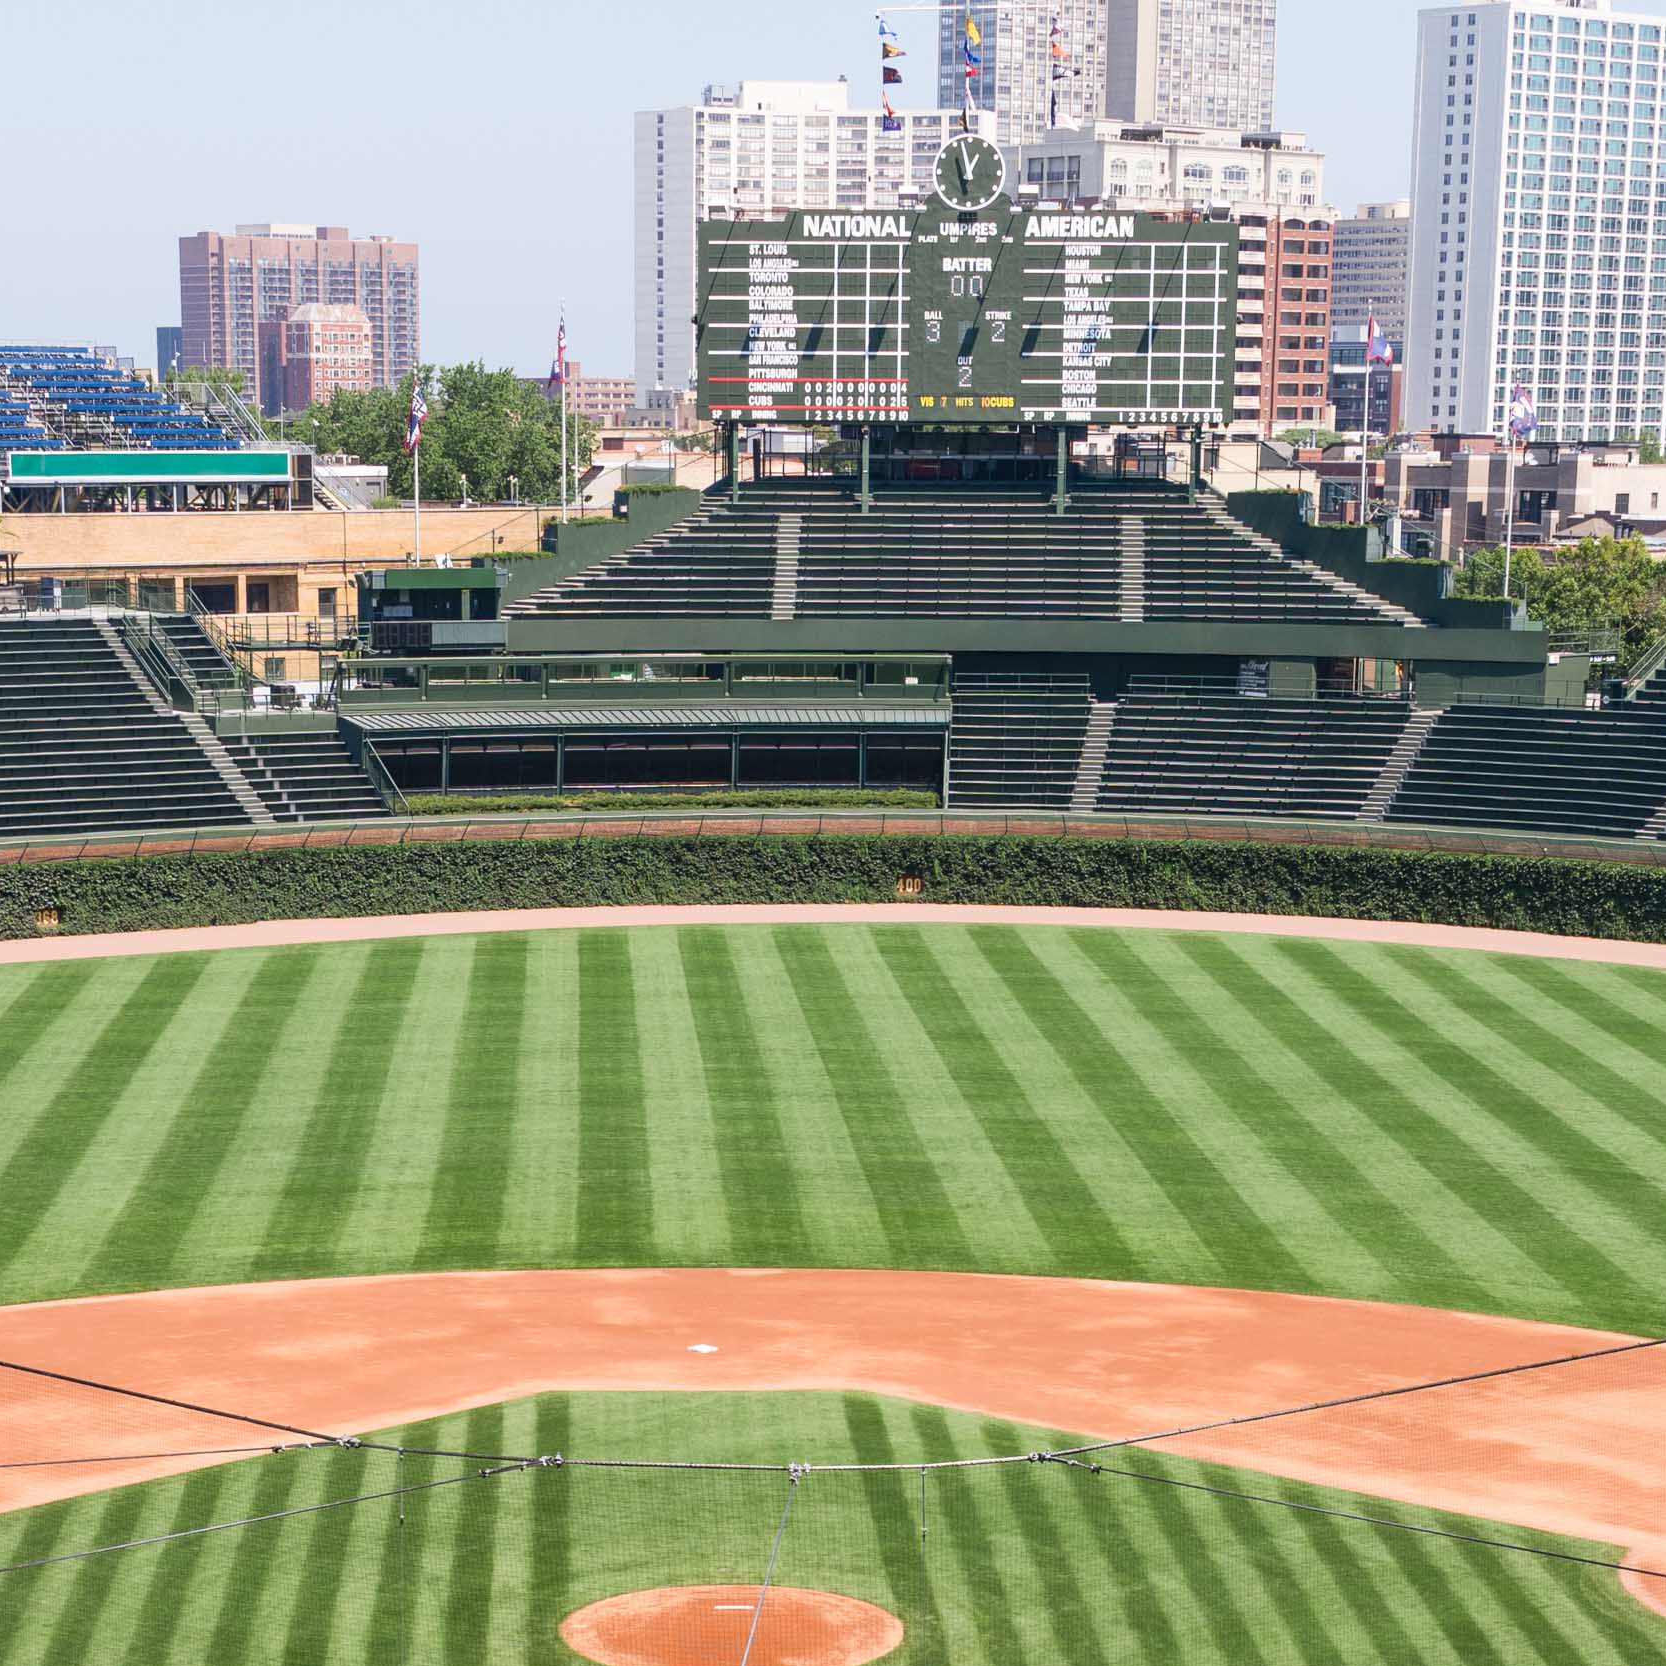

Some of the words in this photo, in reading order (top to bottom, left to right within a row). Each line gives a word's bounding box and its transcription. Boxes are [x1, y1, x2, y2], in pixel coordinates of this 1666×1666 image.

[802, 215, 912, 237] NATIONAL
[939, 222, 998, 236] UMPIRES
[1024, 215, 1134, 238] AMERICAN
[763, 244, 788, 256] LOUIS
[1065, 245, 1102, 257] HOUSTON
[942, 257, 993, 272] BATTER
[748, 272, 789, 283] TORONTO
[1064, 273, 1081, 284] NEW
[1082, 273, 1103, 284] YORK
[748, 285, 794, 297] COLORADO
[1064, 287, 1089, 298] TEXAS
[748, 299, 794, 311] BALTIMORE
[1063, 301, 1092, 312] TAMPA
[1093, 301, 1111, 312] BAY
[748, 313, 798, 324] PHILADELPHIA
[924, 311, 943, 320] BALL
[984, 311, 1012, 320] STRIKE
[748, 327, 796, 338] CLEVELAND
[926, 320, 941, 343] 3
[991, 320, 1006, 343] 2
[1063, 328, 1112, 340] MINNESOTA
[748, 341, 766, 351] NEW
[767, 341, 787, 351] YORK
[1062, 342, 1096, 353] DETROIT
[762, 355, 799, 365] FRANCISCO
[957, 356, 973, 366] OUT
[1062, 356, 1093, 367] KANSAS
[1094, 356, 1113, 367] CITY
[748, 368, 798, 379] PITTSBURGH
[958, 366, 972, 388] 2
[1062, 369, 1096, 381] BOSTON
[748, 382, 794, 393] CINCINNATI
[804, 382, 811, 393] 0
[815, 382, 822, 393] 0
[825, 382, 833, 393] 2
[847, 382, 854, 393] 0
[857, 382, 864, 393] 0
[879, 382, 886, 393] 0
[1061, 383, 1097, 395] CHICAGO
[748, 395, 773, 407] CUBS
[804, 395, 811, 407] 0
[815, 395, 822, 407] 0
[825, 395, 833, 407] 0
[847, 395, 854, 407] 2
[857, 395, 864, 407] 0
[879, 395, 886, 407] 0
[919, 396, 934, 407] VIS
[955, 396, 974, 407] HITS
[990, 396, 1015, 407] CUBS
[1061, 397, 1097, 408] SEATTLE
[712, 410, 723, 420] SP
[805, 410, 809, 420] 1
[814, 410, 822, 420] 2
[825, 410, 833, 420] 3
[835, 410, 843, 420] 4
[847, 410, 854, 420] 5
[857, 410, 865, 420] 6
[868, 410, 874, 420] 7
[878, 410, 886, 420] 8
[889, 410, 896, 420] 9
[897, 410, 909, 420] 10
[1119, 412, 1123, 421] 1
[1128, 412, 1135, 421] 2
[1139, 412, 1146, 421] 3
[1150, 412, 1157, 421] 4
[1161, 412, 1168, 421] 5
[1171, 412, 1178, 421] 6
[1182, 412, 1189, 421] 7
[1193, 412, 1200, 421] 8
[1203, 412, 1210, 421] 9
[1213, 412, 1223, 421] 10
[896, 877, 922, 894] 400
